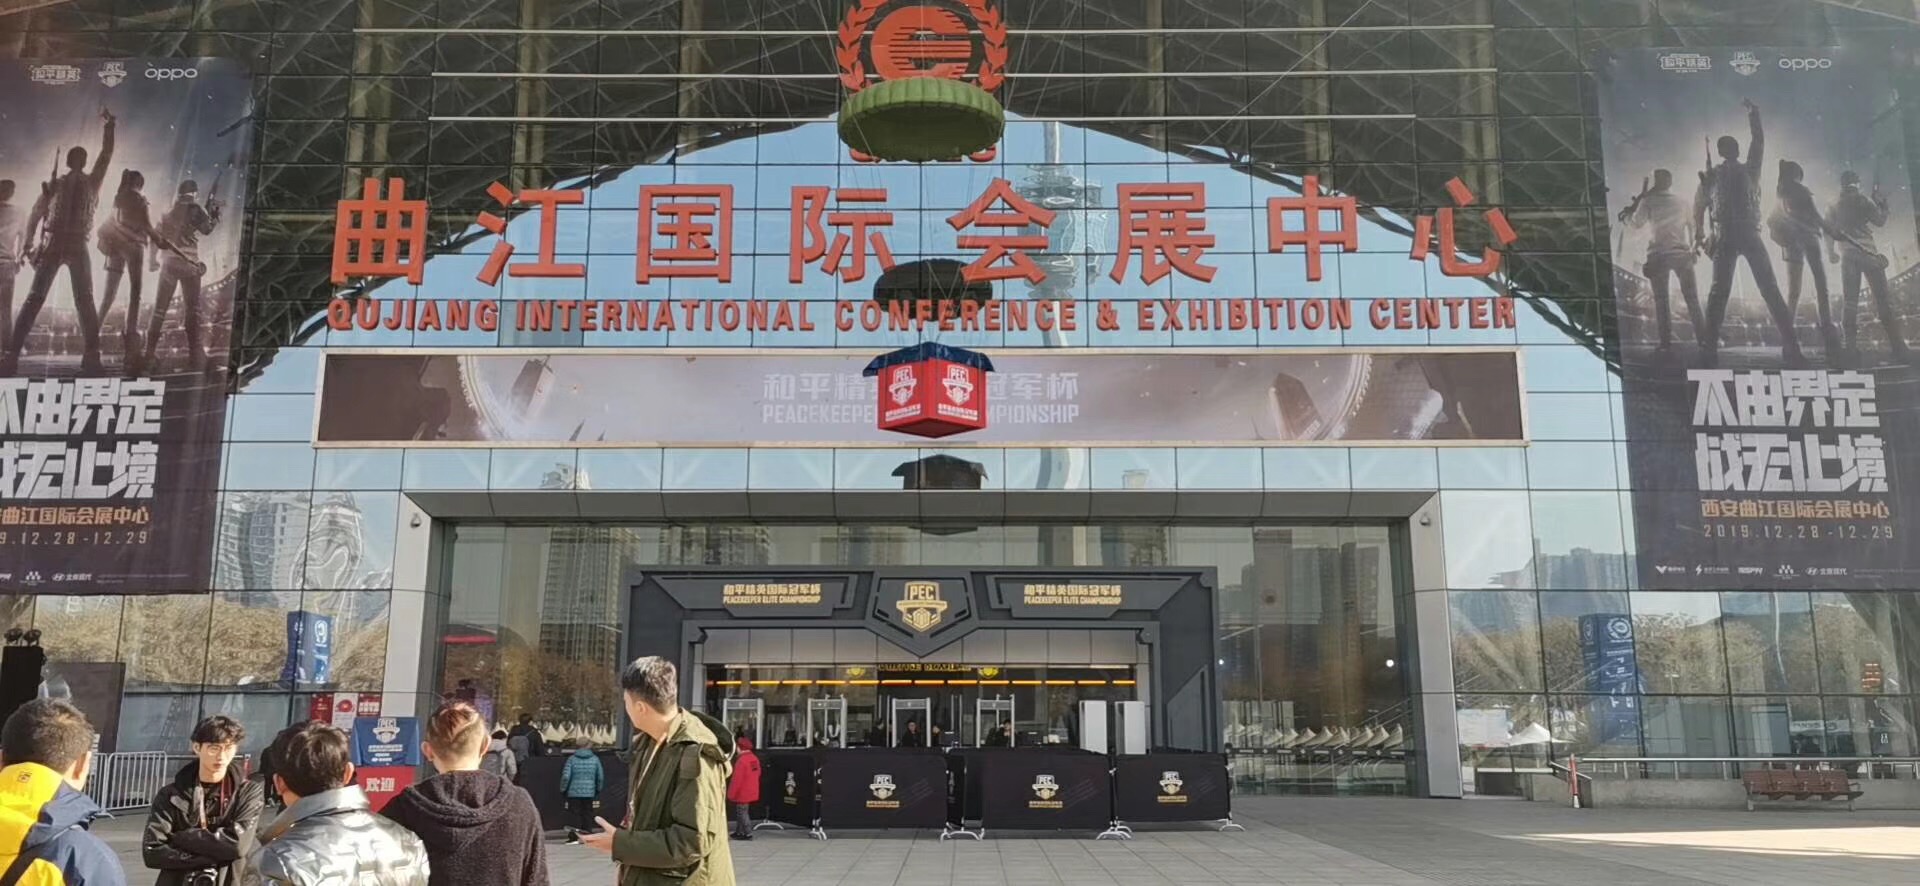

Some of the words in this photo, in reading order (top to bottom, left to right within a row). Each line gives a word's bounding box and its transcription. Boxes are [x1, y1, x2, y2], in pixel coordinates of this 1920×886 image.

[330, 175, 1517, 287] 曲江国际会展中心
[326, 299, 499, 332] QUJIANG
[514, 299, 815, 332] INTERNATIONAL
[835, 299, 1077, 332] CONFERENCE
[1096, 300, 1120, 332] &
[1137, 298, 1352, 331] EXHIBITION
[1369, 297, 1516, 330] CENTER
[1700, 499, 1890, 519] 西安曲江国际会展中心
[909, 585, 934, 601] PEC
[365, 777, 395, 793] 欢迎
